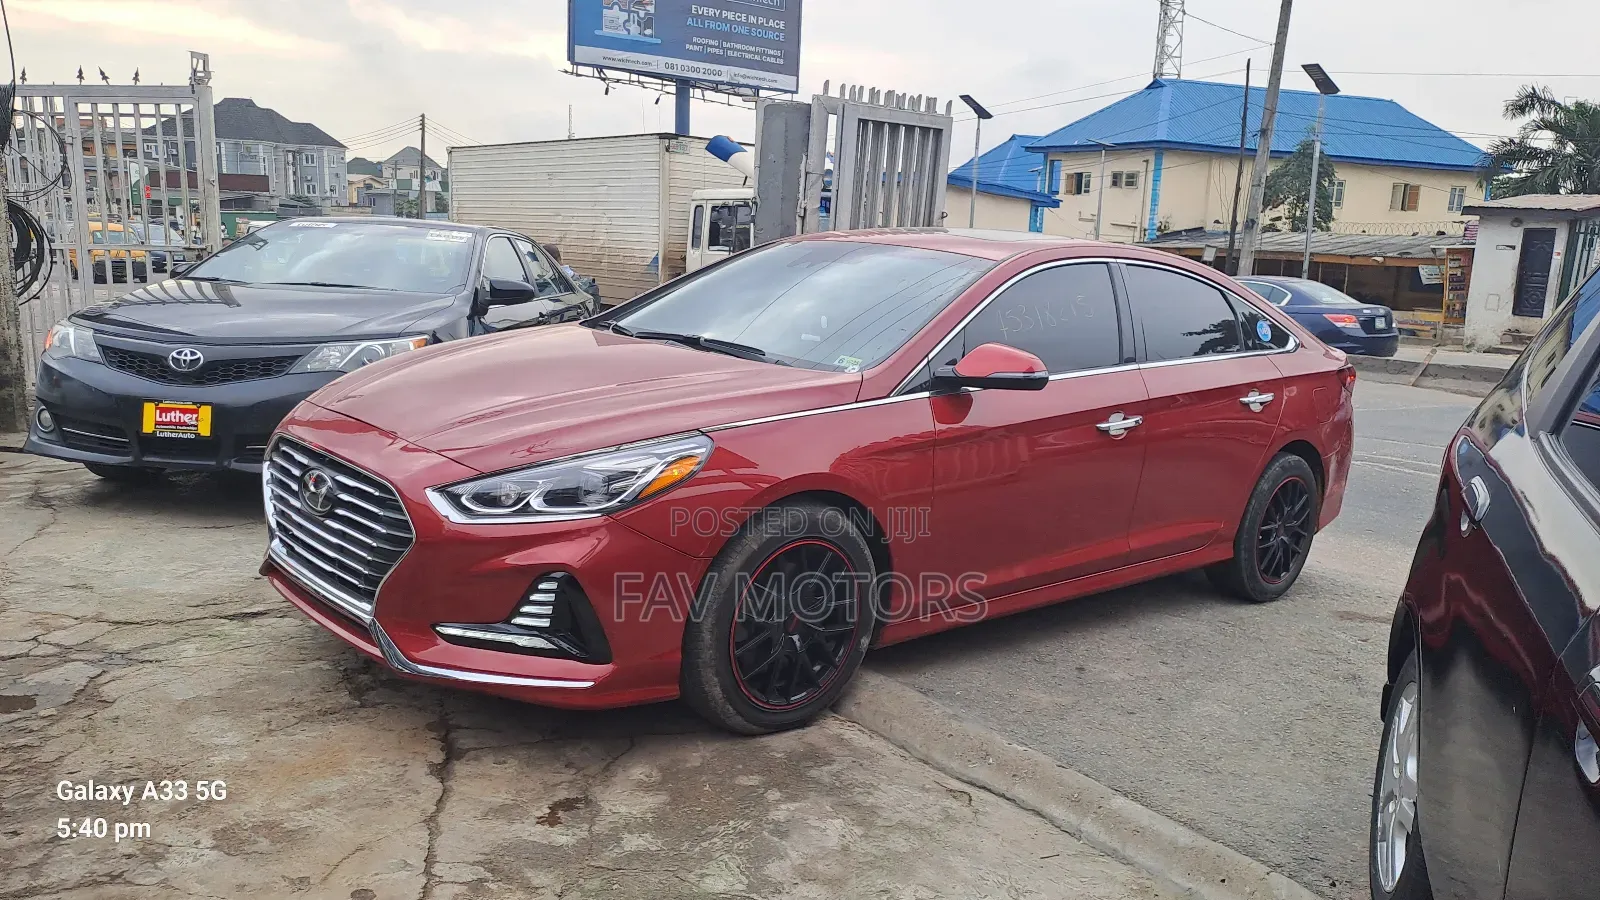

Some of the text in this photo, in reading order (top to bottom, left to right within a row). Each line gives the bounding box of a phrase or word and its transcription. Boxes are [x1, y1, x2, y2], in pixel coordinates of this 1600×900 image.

[692, 5, 785, 29] EVERY PIECE IN PLACE
[686, 17, 785, 41] ALL FROM ONE SOURCE
[685, 44, 784, 65] PAINT PIPES ELECTRICAL CABLES
[692, 37, 781, 56] ROOFING BATHROOM FITTINGS
[664, 62, 722, 77] 081 0300 2000
[156, 409, 198, 423] Luther
[156, 431, 195, 439] LutherAuto
